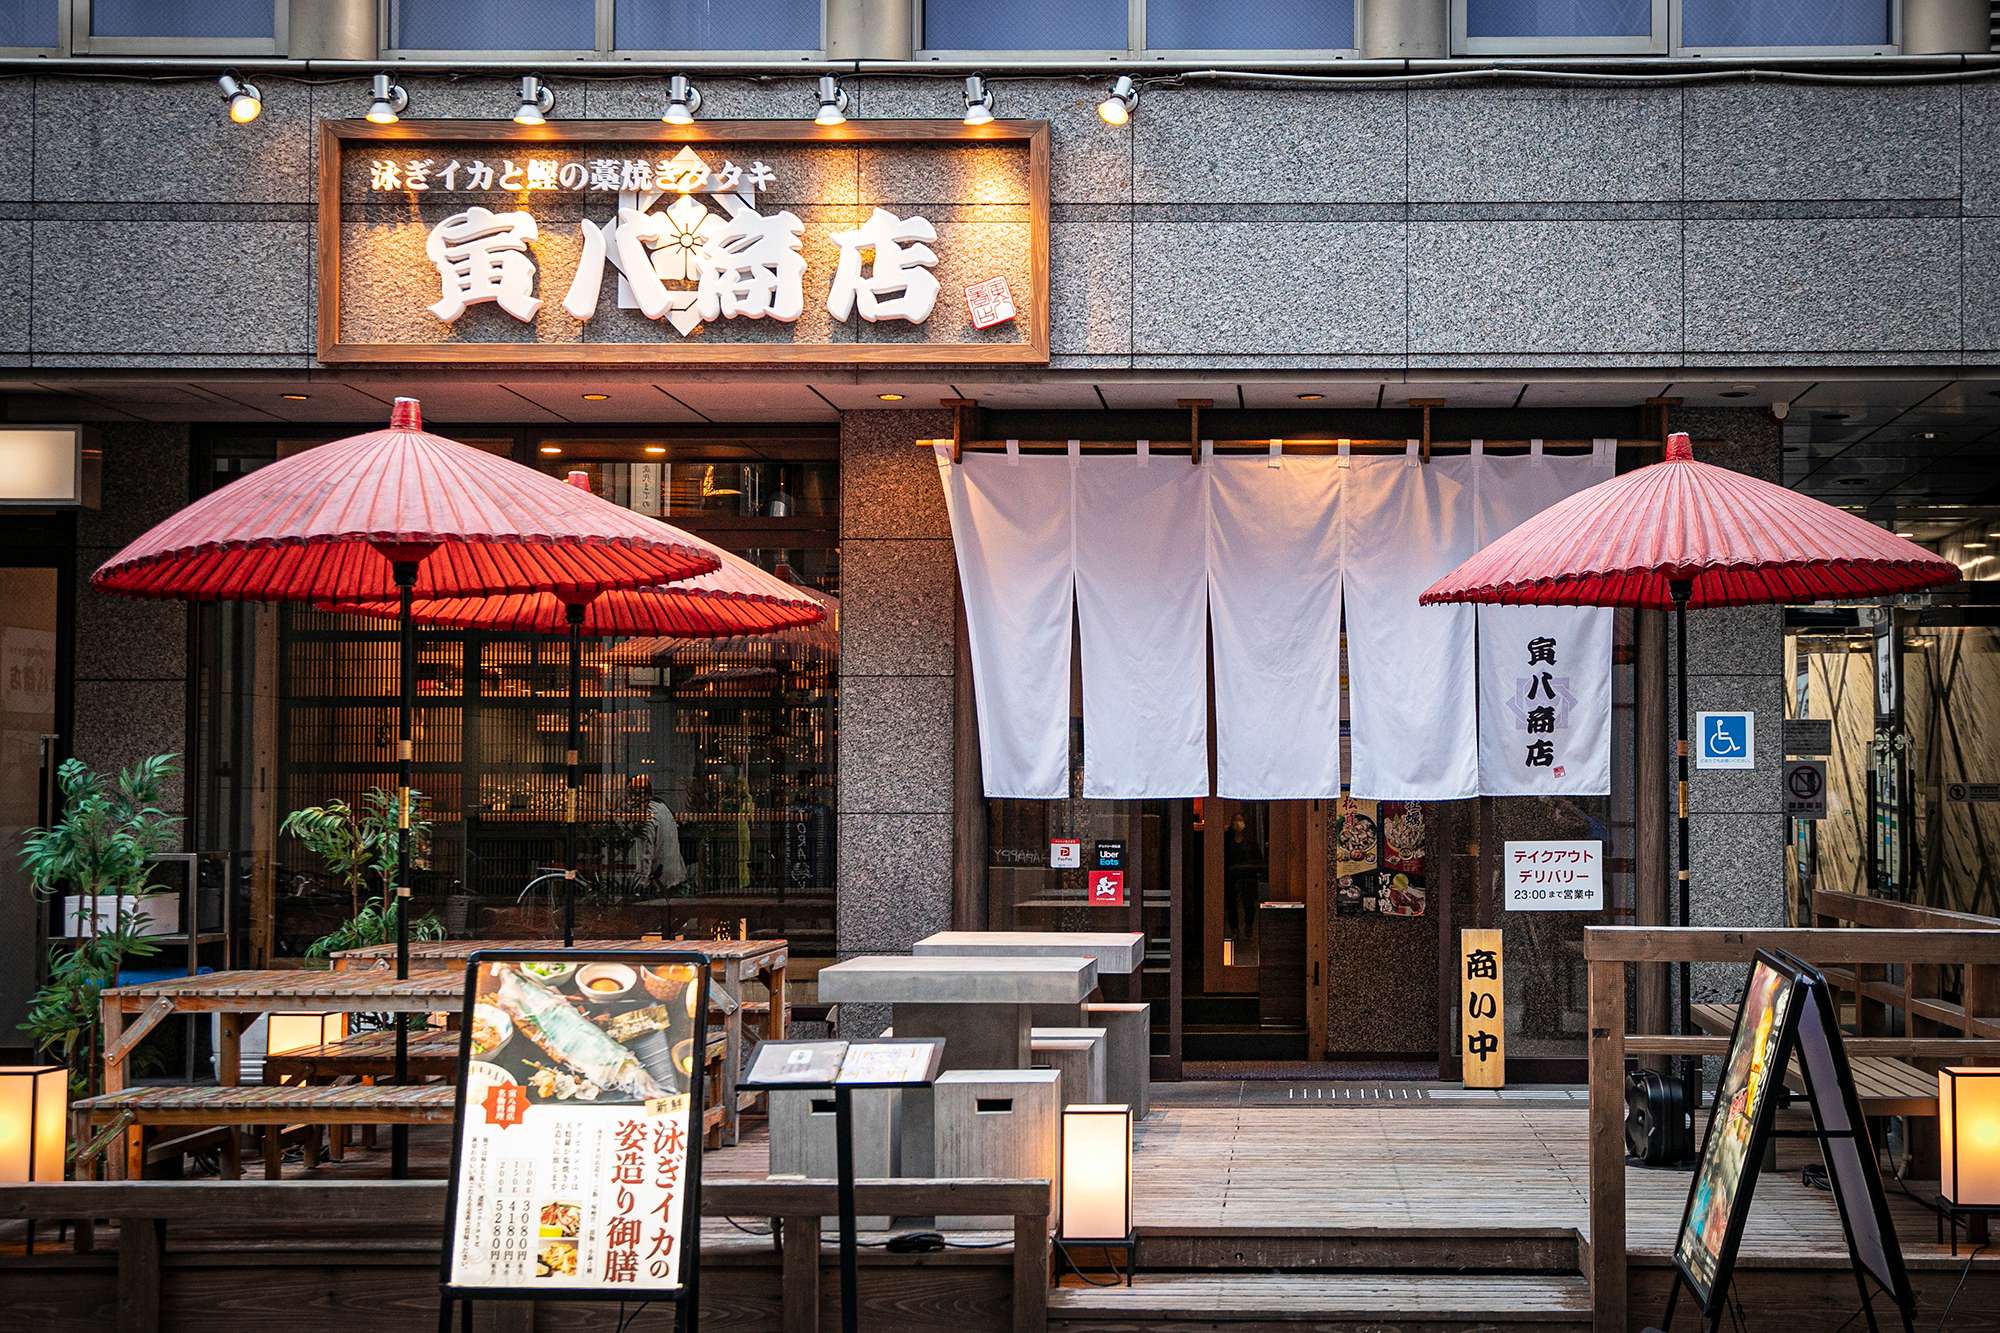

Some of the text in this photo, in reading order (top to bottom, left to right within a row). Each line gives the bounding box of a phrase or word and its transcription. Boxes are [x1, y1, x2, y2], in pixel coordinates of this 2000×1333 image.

[425, 206, 943, 324] 寅八商店
[1525, 636, 1557, 768] 寅八商店
[1099, 850, 1119, 859] Uber
[1099, 858, 1119, 866] Eats
[1514, 850, 1593, 863] テイクアウト
[1519, 870, 1589, 883] デリバリー
[1466, 949, 1498, 1062] 商い中
[603, 1119, 648, 1283] 姿造り御膳
[645, 1119, 687, 1279] 泳ぎイカの
[490, 1200, 503, 1261] 5280円
[503, 1200, 517, 1261] 4180円
[517, 1200, 531, 1261] 3080円
